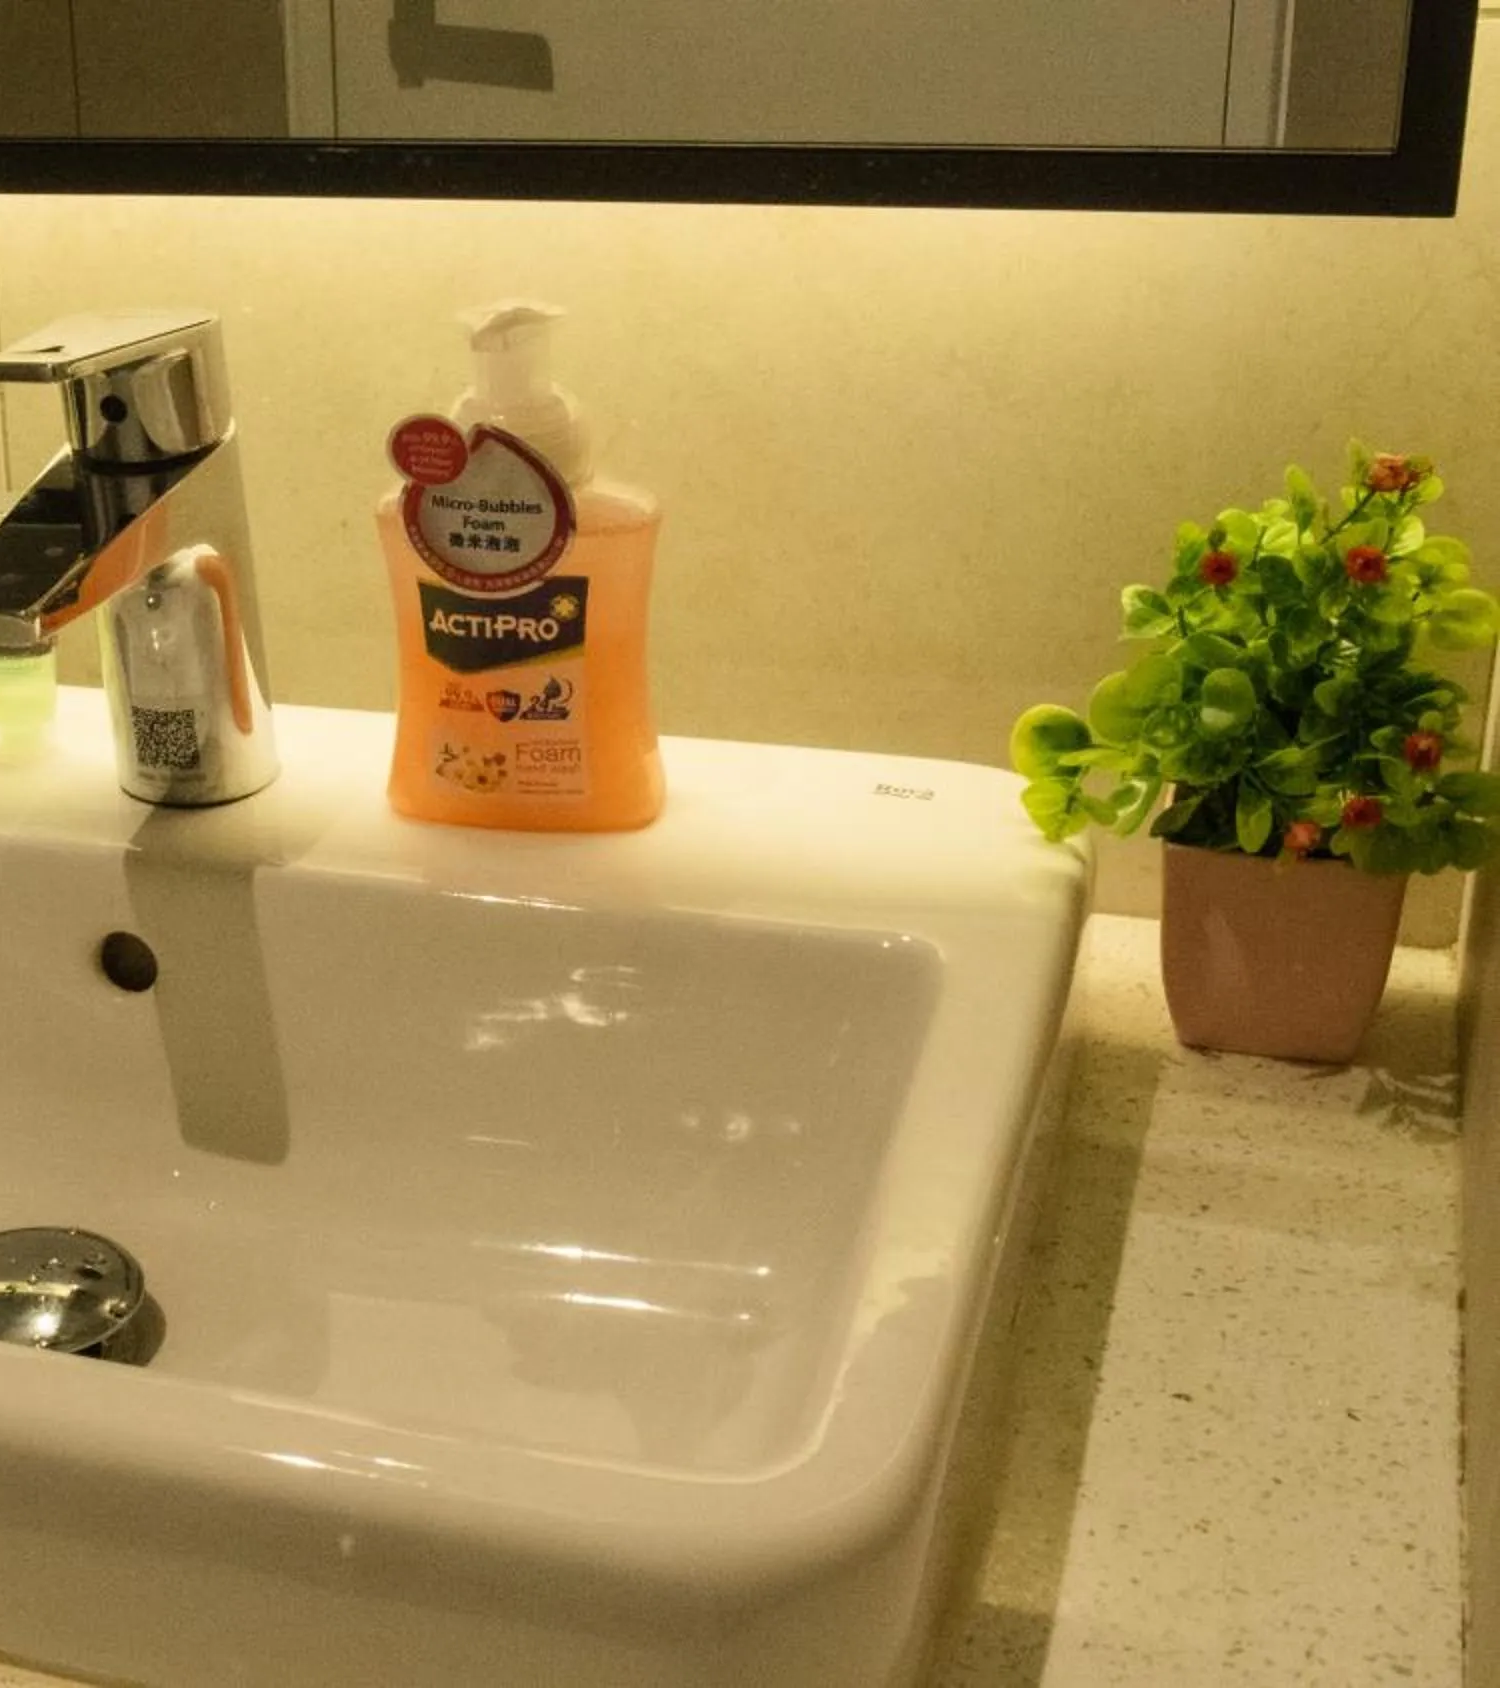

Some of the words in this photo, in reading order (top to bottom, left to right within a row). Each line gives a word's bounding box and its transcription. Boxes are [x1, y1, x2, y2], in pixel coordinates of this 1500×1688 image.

[431, 494, 543, 514] Micro-Bubbles
[463, 515, 505, 532] Foam
[515, 743, 581, 762] Foam
